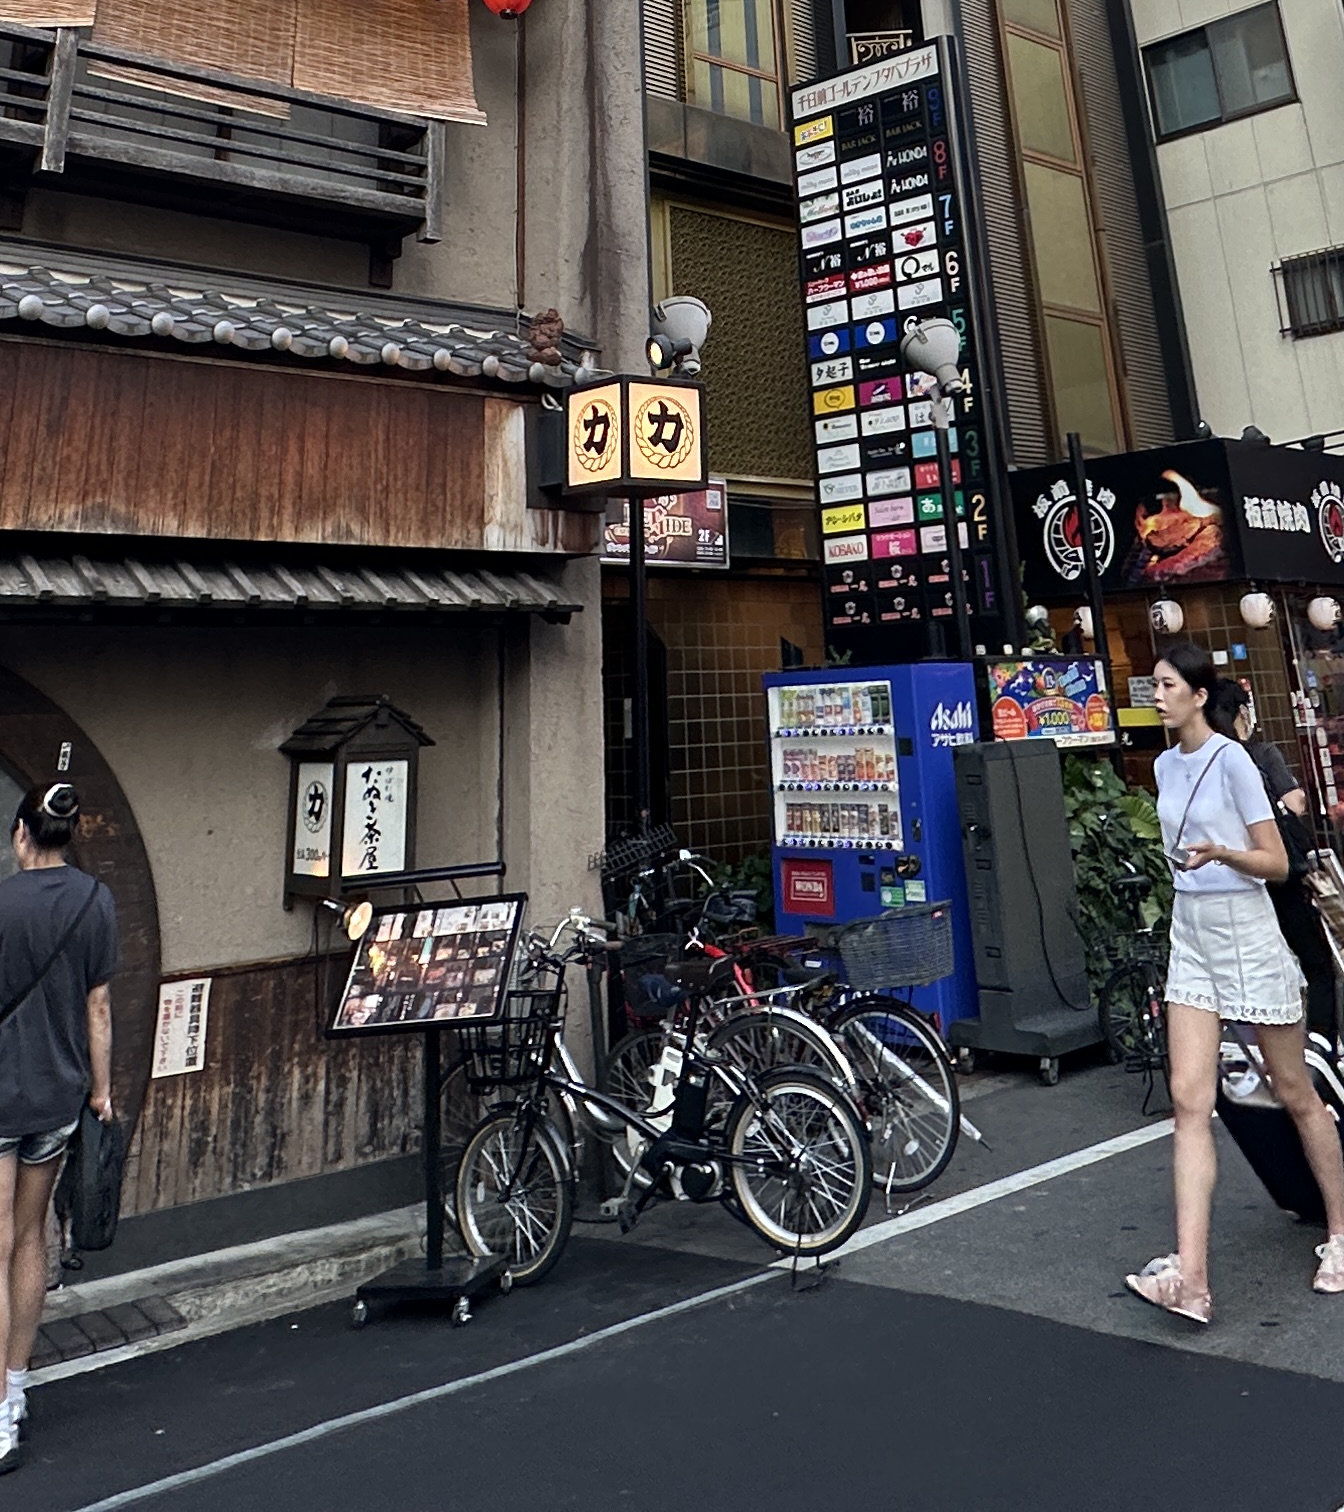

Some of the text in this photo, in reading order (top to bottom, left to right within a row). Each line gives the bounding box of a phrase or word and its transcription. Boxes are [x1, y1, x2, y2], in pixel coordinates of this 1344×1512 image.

[938, 194, 954, 236] 7F
[945, 251, 961, 293] 6F
[583, 405, 610, 455] 力
[648, 401, 684, 453] 力
[971, 494, 987, 540] 2F
[931, 701, 972, 731] Asahi
[308, 784, 325, 822] 力
